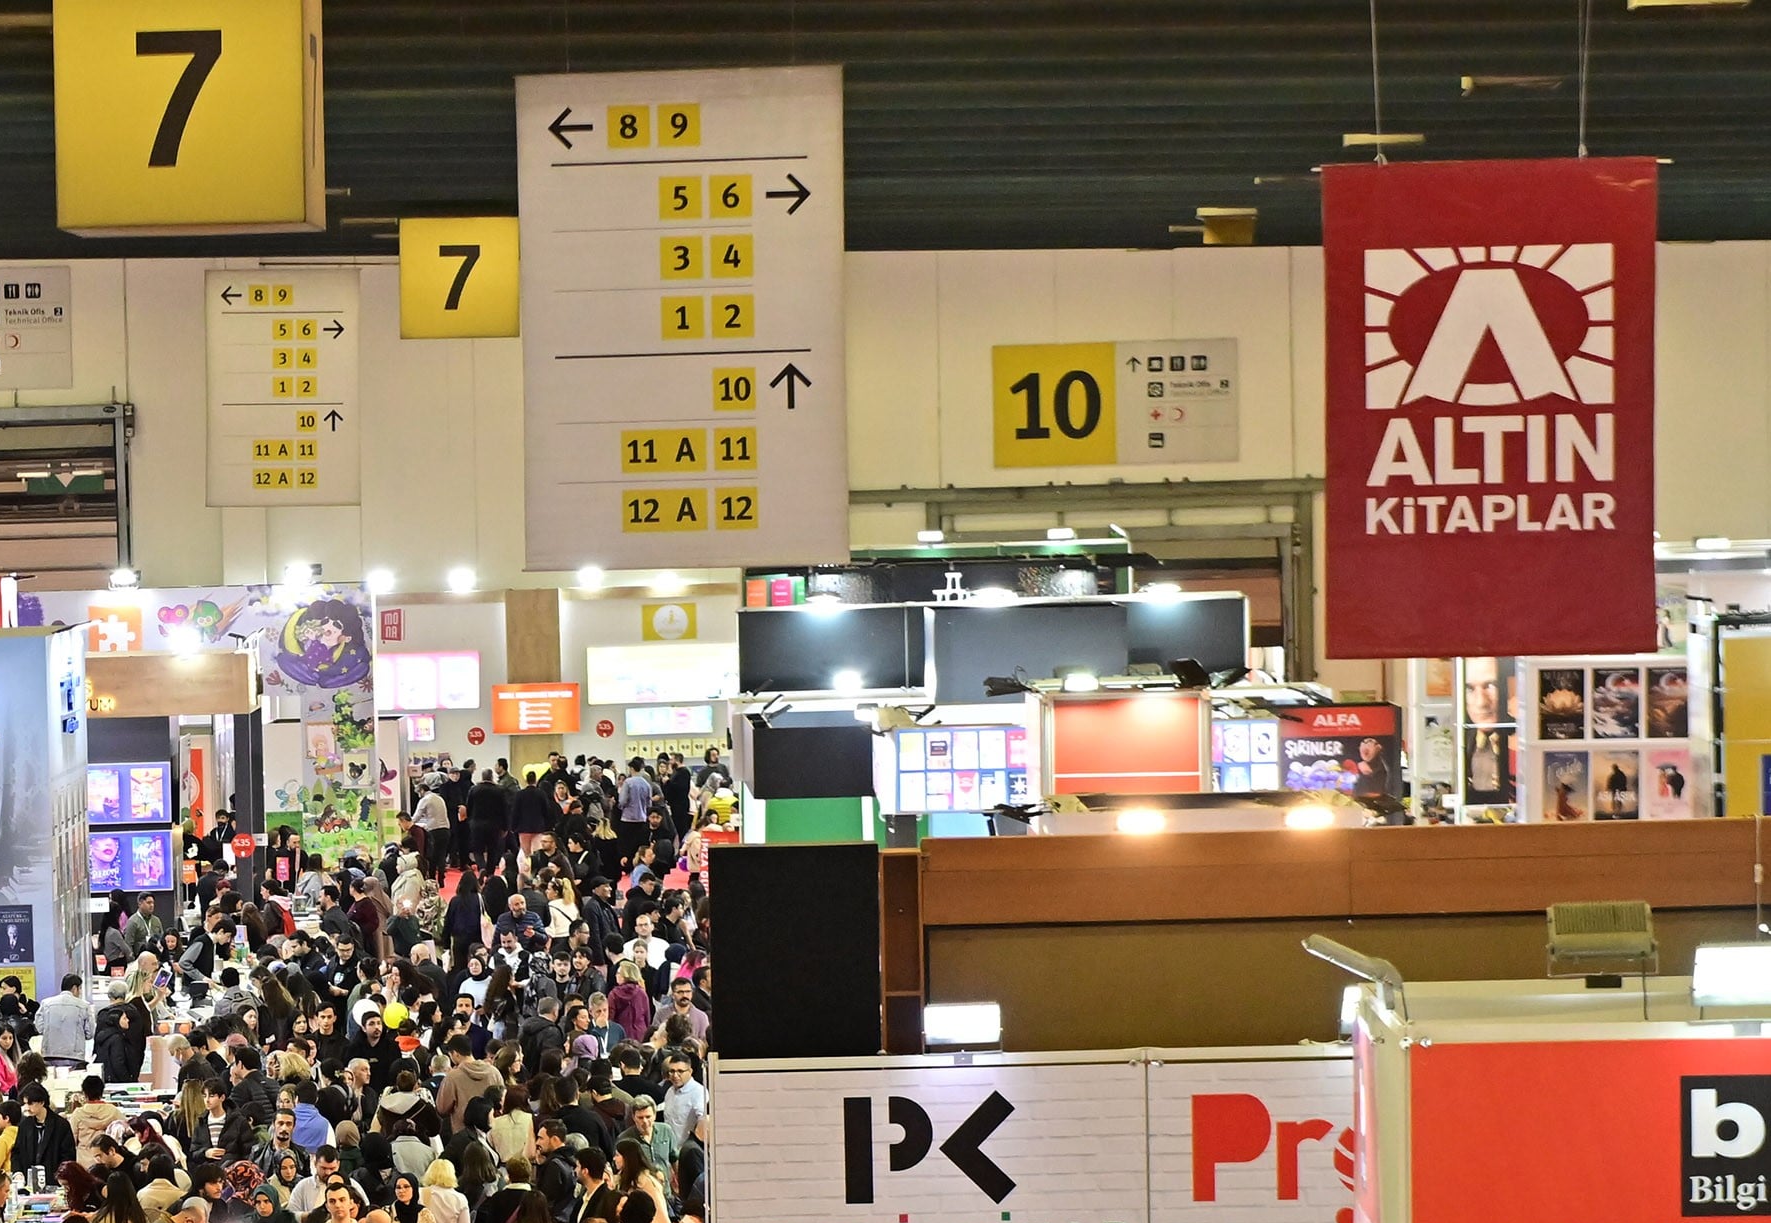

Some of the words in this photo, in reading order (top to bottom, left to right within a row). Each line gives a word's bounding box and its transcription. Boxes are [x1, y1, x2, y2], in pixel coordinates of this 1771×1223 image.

[135, 29, 223, 169] 7
[619, 114, 638, 140] 8
[670, 112, 688, 139] 9
[673, 185, 689, 211] 5
[722, 182, 740, 209] 6
[673, 245, 690, 271] 3
[723, 243, 741, 269] 4
[438, 244, 481, 311] 7
[254, 289, 264, 302] 8
[278, 288, 288, 302] 9
[279, 323, 287, 337] 5
[302, 322, 311, 336] 6
[675, 305, 690, 330] 1
[724, 303, 742, 329] 2
[278, 352, 287, 365] 3
[302, 352, 311, 364] 4
[279, 381, 286, 393] 1
[302, 380, 311, 393] 2
[718, 376, 751, 402] 10
[1008, 369, 1102, 441] 10
[299, 415, 315, 428] 10
[255, 444, 270, 457] 11
[278, 443, 288, 457] A
[299, 443, 314, 457] 11
[627, 439, 658, 464] 11
[675, 437, 696, 463] A
[720, 436, 751, 462] 11
[1367, 413, 1615, 487] ALTIN
[255, 472, 271, 485] 12
[278, 472, 289, 485] A
[299, 472, 315, 485] 12
[628, 498, 660, 524] 12
[676, 496, 697, 523] A
[721, 495, 753, 521] 12
[384, 614, 399, 625] MO
[1313, 714, 1362, 727] ALFA
[1690, 1088, 1766, 1159] b
[1690, 1174, 1769, 1211] Bilgi
